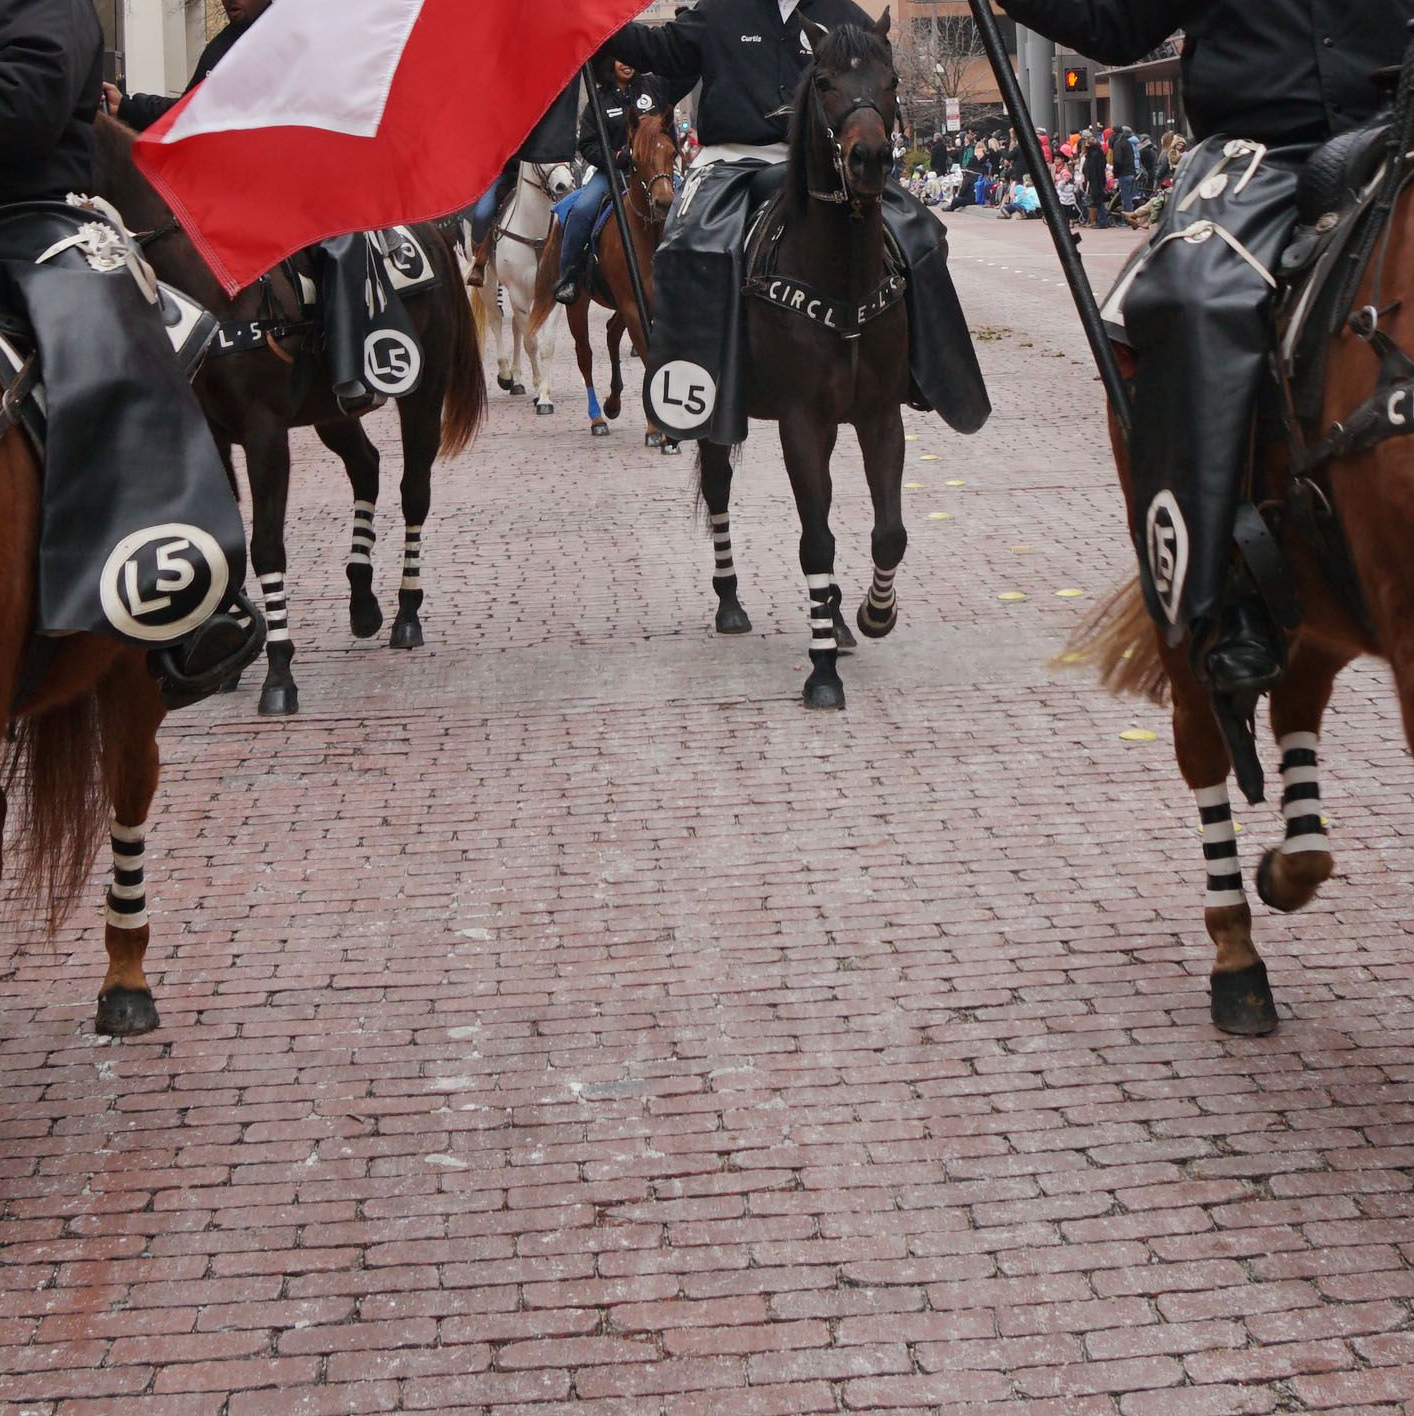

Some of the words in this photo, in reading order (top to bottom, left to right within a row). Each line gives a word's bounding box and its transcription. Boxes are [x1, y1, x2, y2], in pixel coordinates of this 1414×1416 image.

[769, 281, 867, 328] CIRCLE
[368, 341, 410, 379] L5
[663, 370, 707, 416] L5
[125, 538, 195, 618] L5
